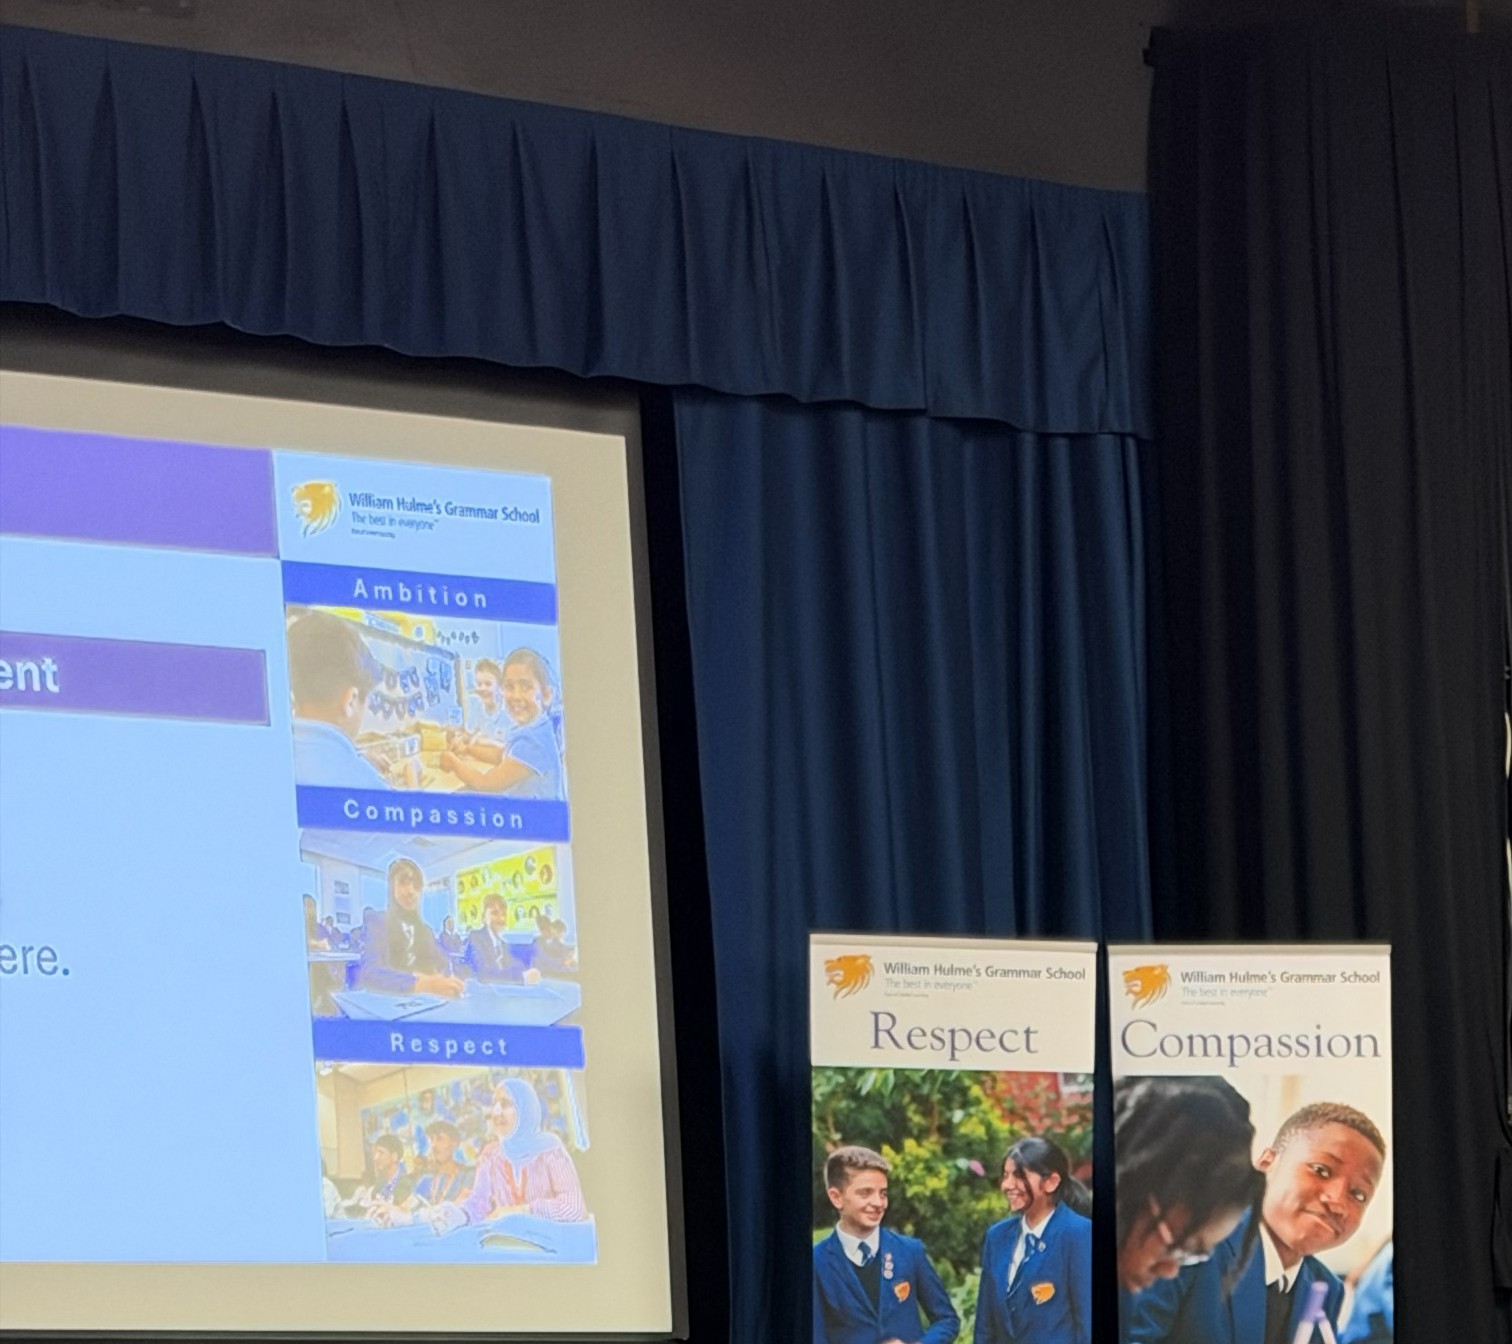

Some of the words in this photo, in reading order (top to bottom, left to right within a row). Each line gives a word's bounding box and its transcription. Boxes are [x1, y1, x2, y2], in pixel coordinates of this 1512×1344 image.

[348, 492, 394, 510] William
[396, 496, 442, 515] Hulme's
[444, 501, 499, 519] Grammar
[502, 506, 540, 523] School
[351, 511, 366, 523] The
[368, 513, 387, 526] best
[353, 578, 487, 608] Ambition
[343, 799, 523, 828] Compassion
[884, 962, 930, 975] William
[934, 963, 981, 978] Hulme's
[985, 965, 1042, 979] Grammar
[1046, 967, 1086, 980] School
[885, 978, 902, 989] The
[903, 979, 921, 989] best
[1181, 971, 1226, 983] William
[1229, 971, 1277, 984] Hulme's
[1280, 971, 1336, 984] Grammar
[1340, 971, 1380, 984] School
[390, 1033, 508, 1058] Respect
[870, 1011, 1039, 1061] Respect
[1121, 1019, 1382, 1067] Compassion
